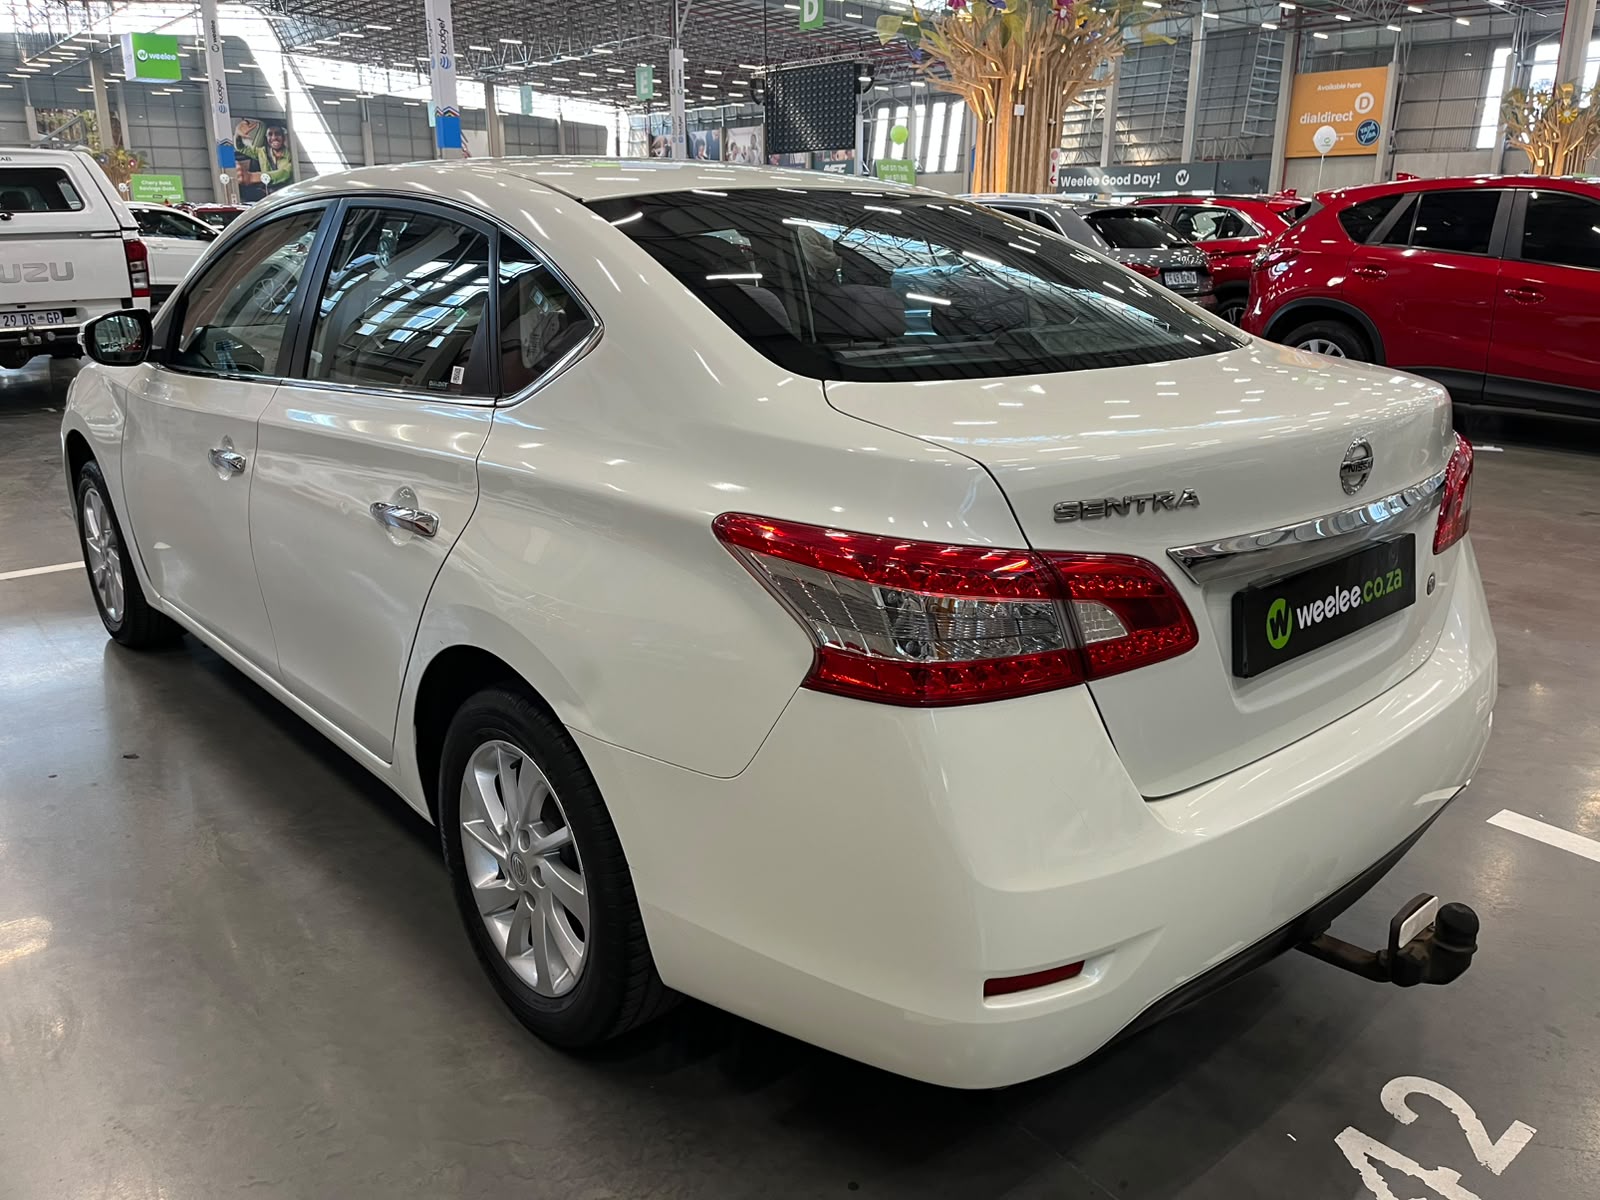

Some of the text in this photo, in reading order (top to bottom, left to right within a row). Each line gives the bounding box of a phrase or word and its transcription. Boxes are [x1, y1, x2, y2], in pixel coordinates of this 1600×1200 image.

[804, 0, 819, 23] D
[436, 18, 449, 55] budget
[149, 52, 177, 61] weelee
[216, 79, 225, 104] budget
[640, 71, 649, 94] E
[1317, 83, 1346, 91] Available
[1300, 111, 1354, 124] dialdirect
[1060, 172, 1161, 188] Weelee Good Day!
[21, 313, 36, 325] DG
[46, 311, 61, 324] GP
[1053, 487, 1201, 524] SENTRA
[1296, 567, 1403, 630] weelee.co.za
